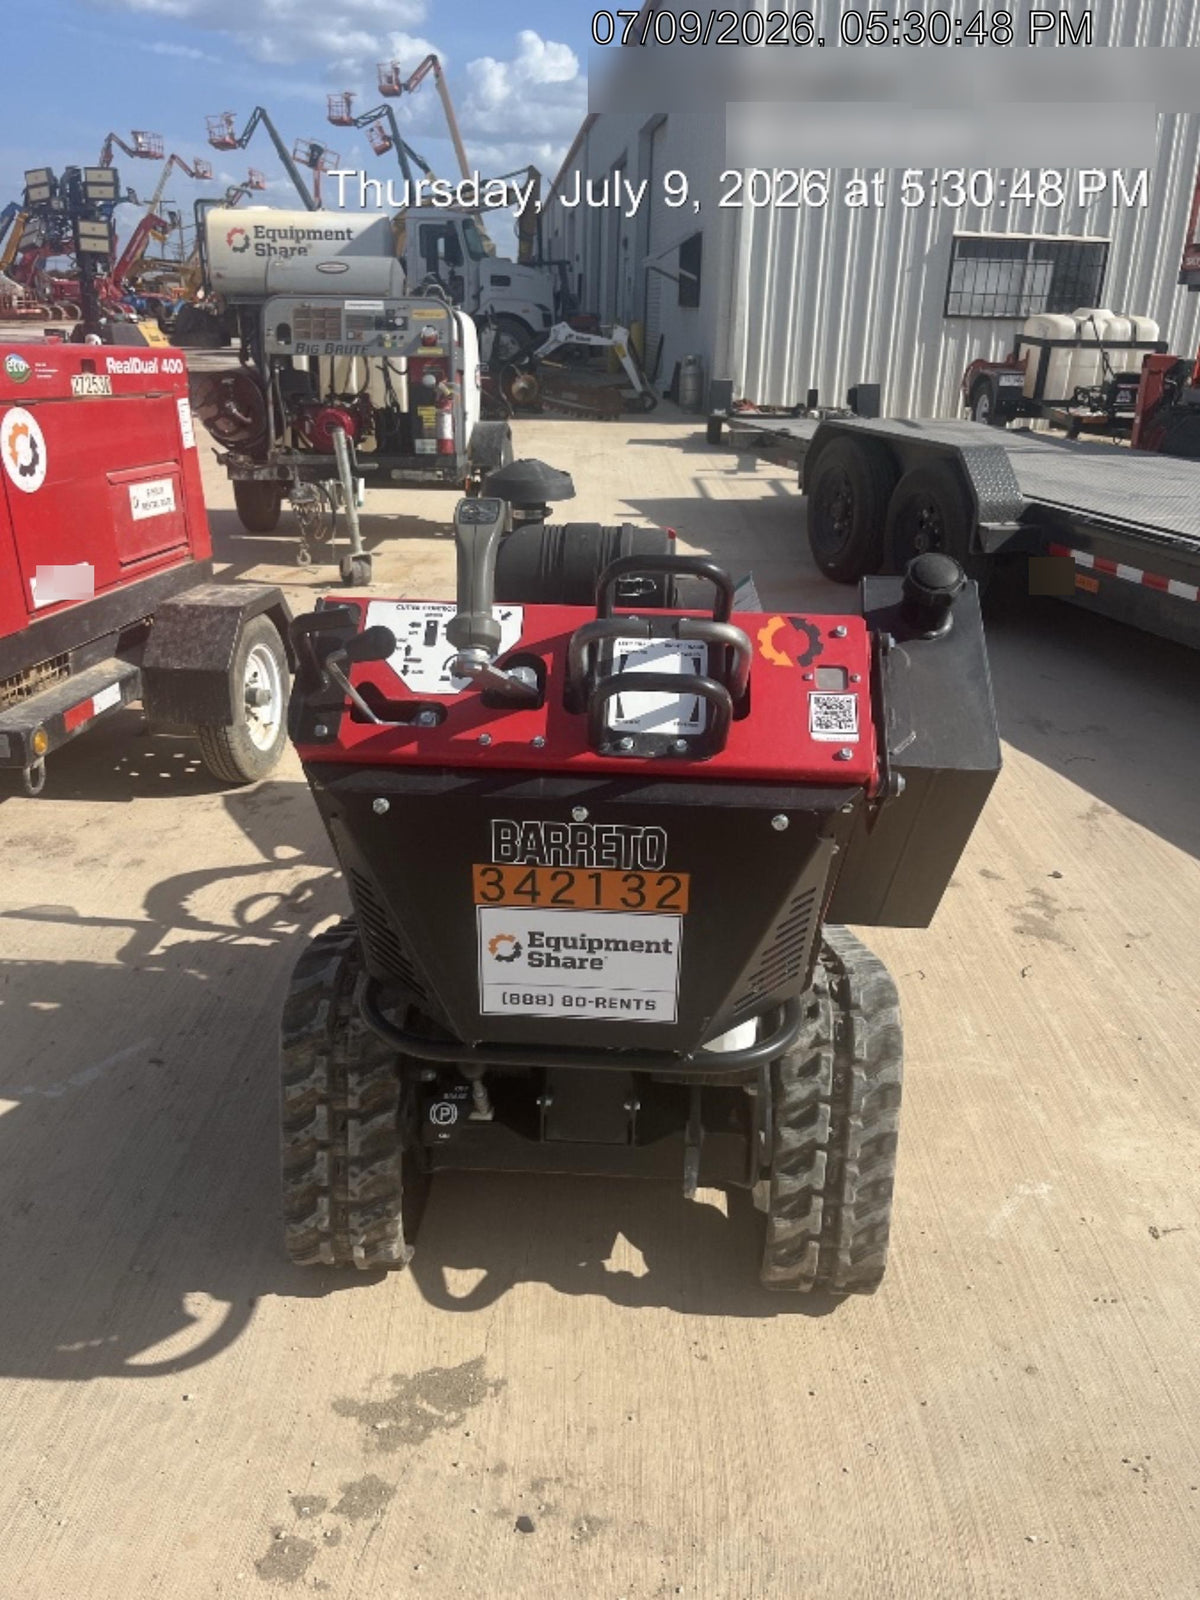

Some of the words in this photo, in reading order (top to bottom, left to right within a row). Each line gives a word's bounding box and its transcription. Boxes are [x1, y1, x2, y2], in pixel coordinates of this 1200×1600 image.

[253, 225, 354, 244] Equipment
[105, 356, 159, 375] RealDual
[161, 358, 184, 375] 400
[490, 818, 668, 870] BARRETO
[479, 866, 683, 910] 342132
[527, 931, 673, 955] Equipment
[501, 992, 555, 1006] (888)
